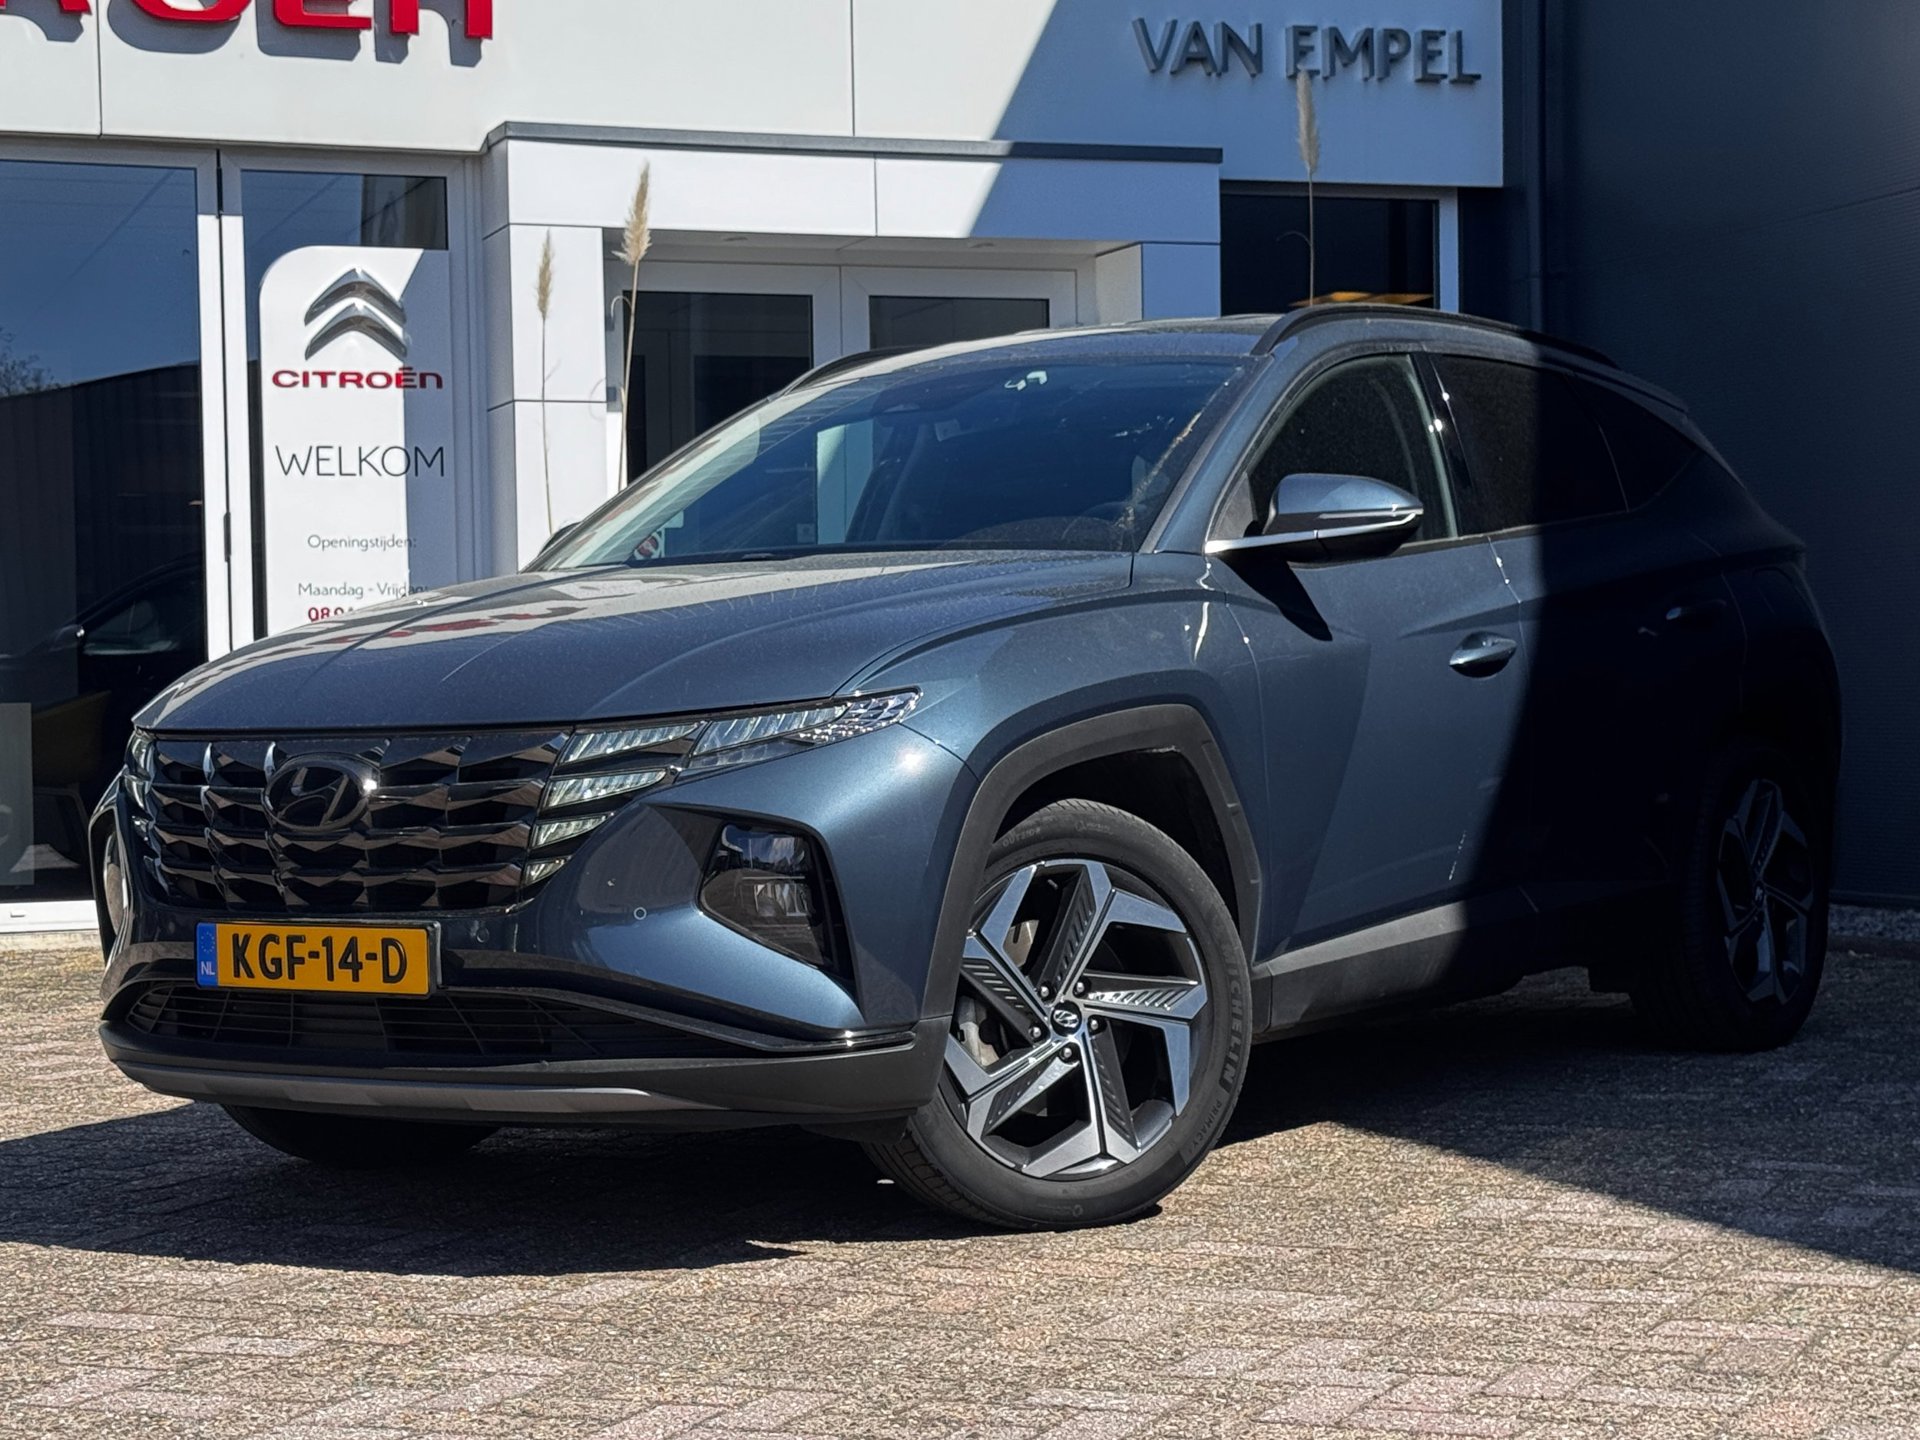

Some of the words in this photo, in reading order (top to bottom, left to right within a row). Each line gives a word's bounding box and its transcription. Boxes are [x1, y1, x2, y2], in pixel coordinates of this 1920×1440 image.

[1132, 17, 1263, 78] VAN
[1285, 25, 1482, 84] EMPEL
[275, 445, 445, 477] WELKOM
[307, 533, 417, 552] Openingstijden:
[298, 582, 364, 600] Maandag
[200, 961, 215, 976] NL
[232, 933, 407, 984] KGF-14-D
[1222, 943, 1243, 1085] MICHELIN
